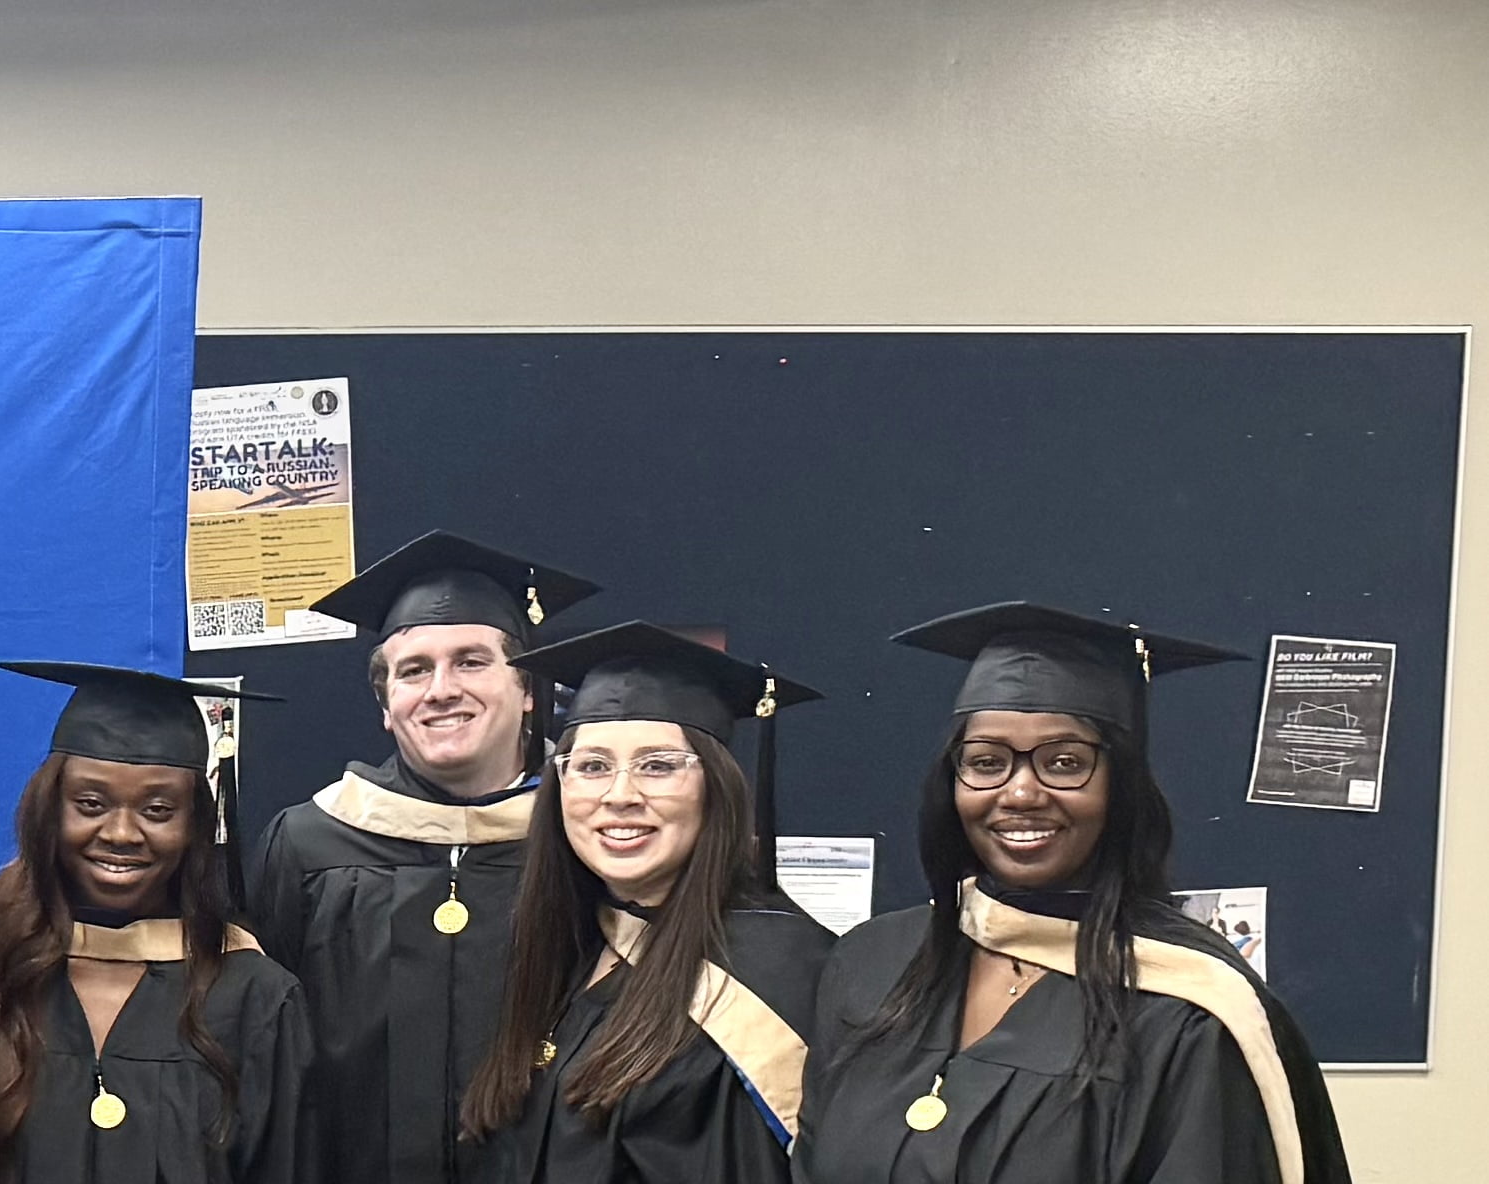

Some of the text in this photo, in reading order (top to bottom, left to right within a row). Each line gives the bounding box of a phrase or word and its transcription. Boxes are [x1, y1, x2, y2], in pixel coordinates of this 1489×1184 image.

[191, 437, 335, 466] STARTALK:
[191, 466, 222, 479] TRIP
[228, 464, 247, 475] TO
[266, 470, 338, 485] COUNTRY
[1294, 652, 1314, 661] YOU
